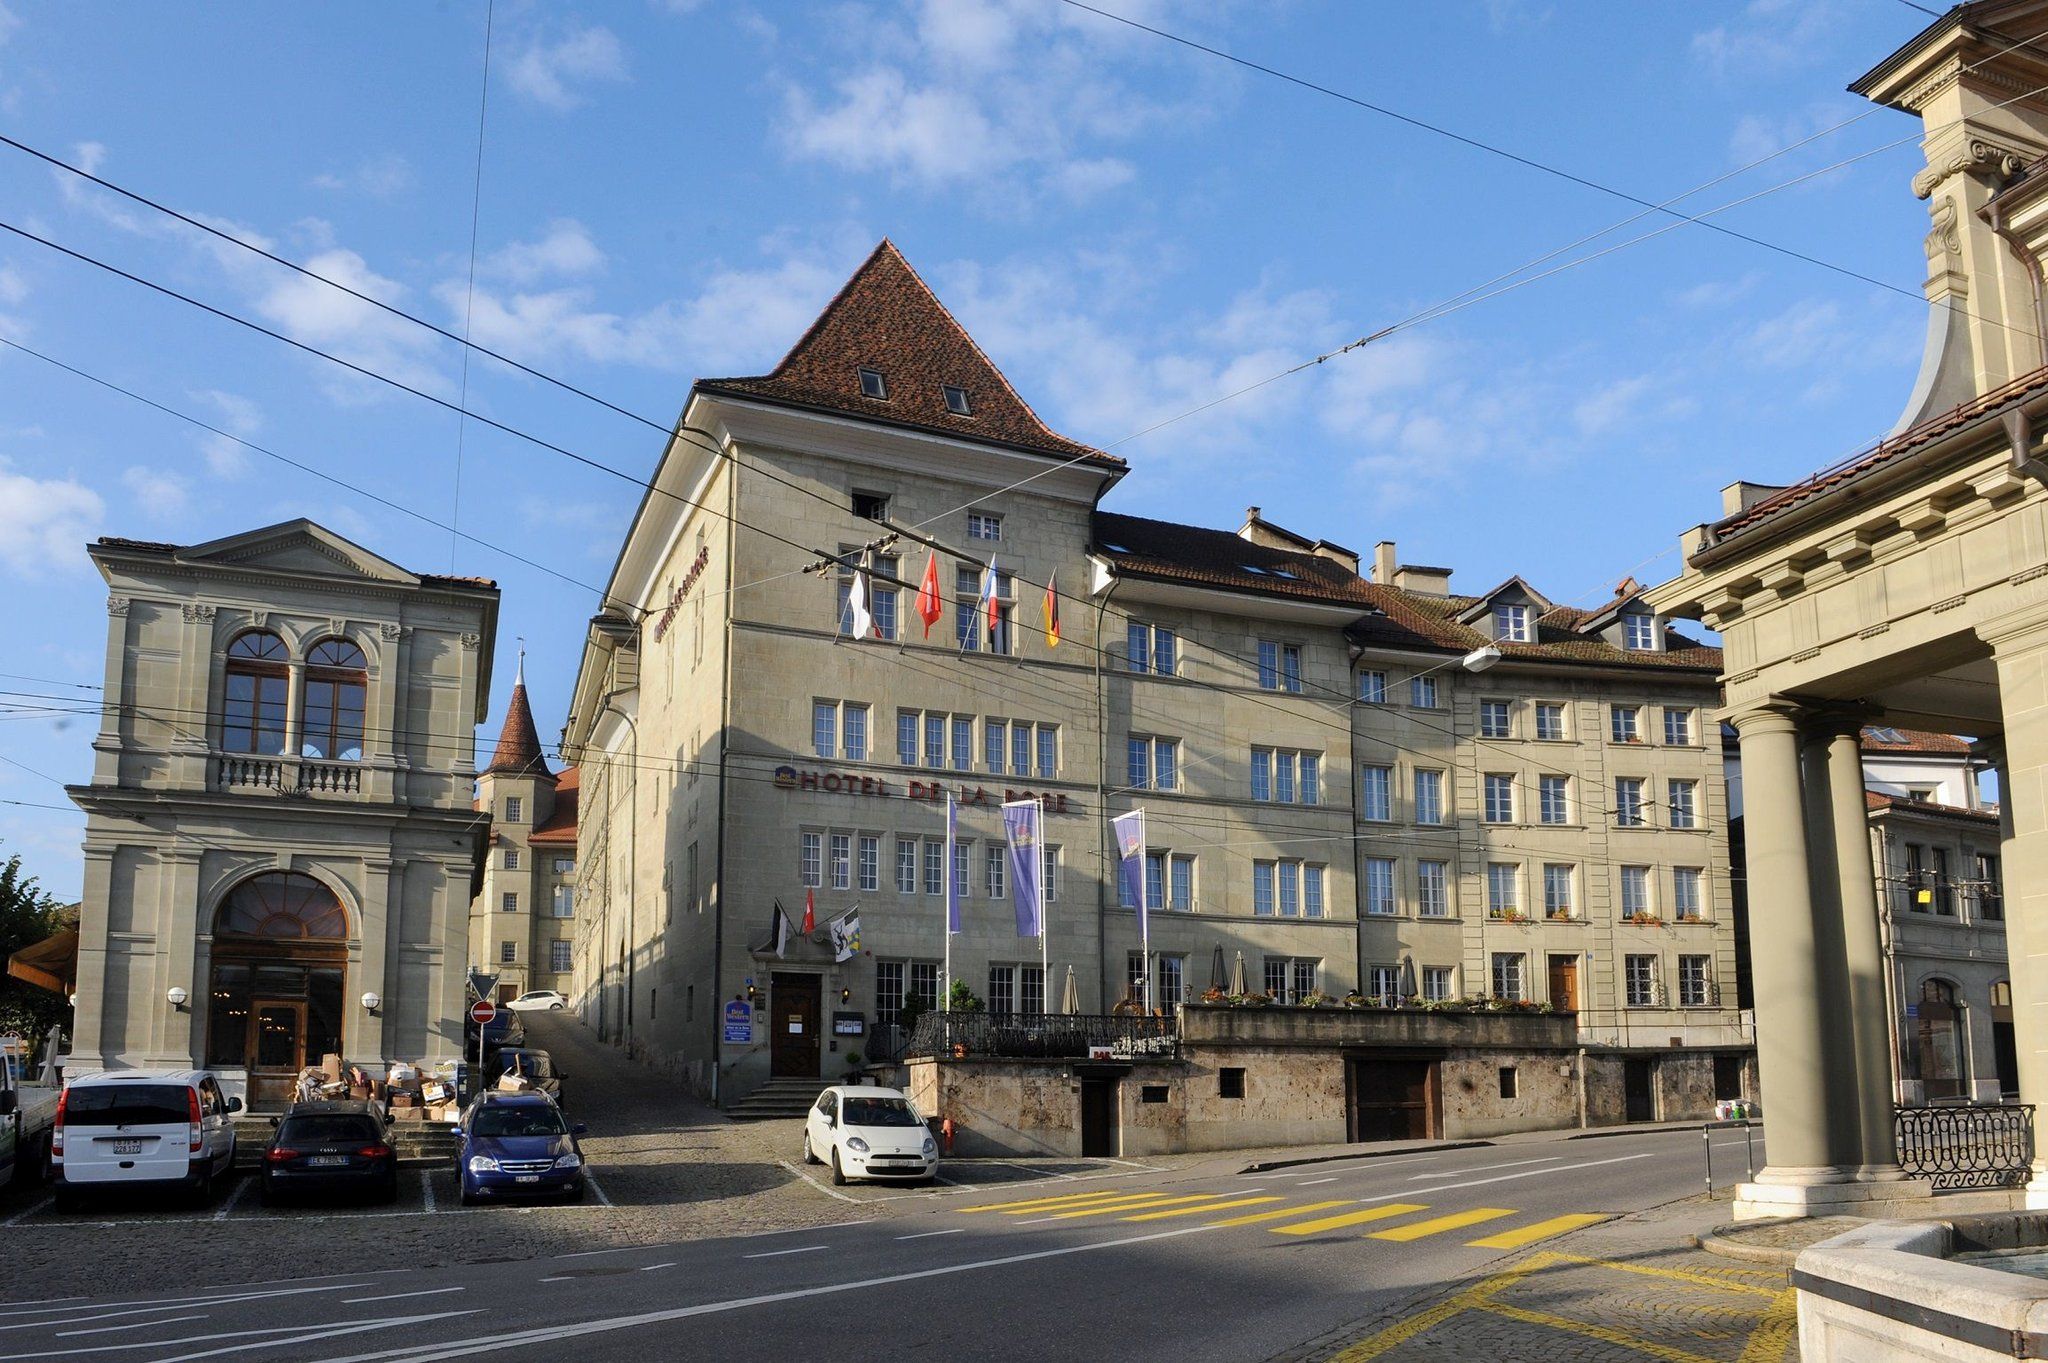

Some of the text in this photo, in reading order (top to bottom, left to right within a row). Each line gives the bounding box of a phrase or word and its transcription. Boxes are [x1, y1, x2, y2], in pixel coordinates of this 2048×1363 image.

[801, 770, 890, 796] HOTEL
[908, 780, 942, 801] DE
[960, 785, 987, 804] LA
